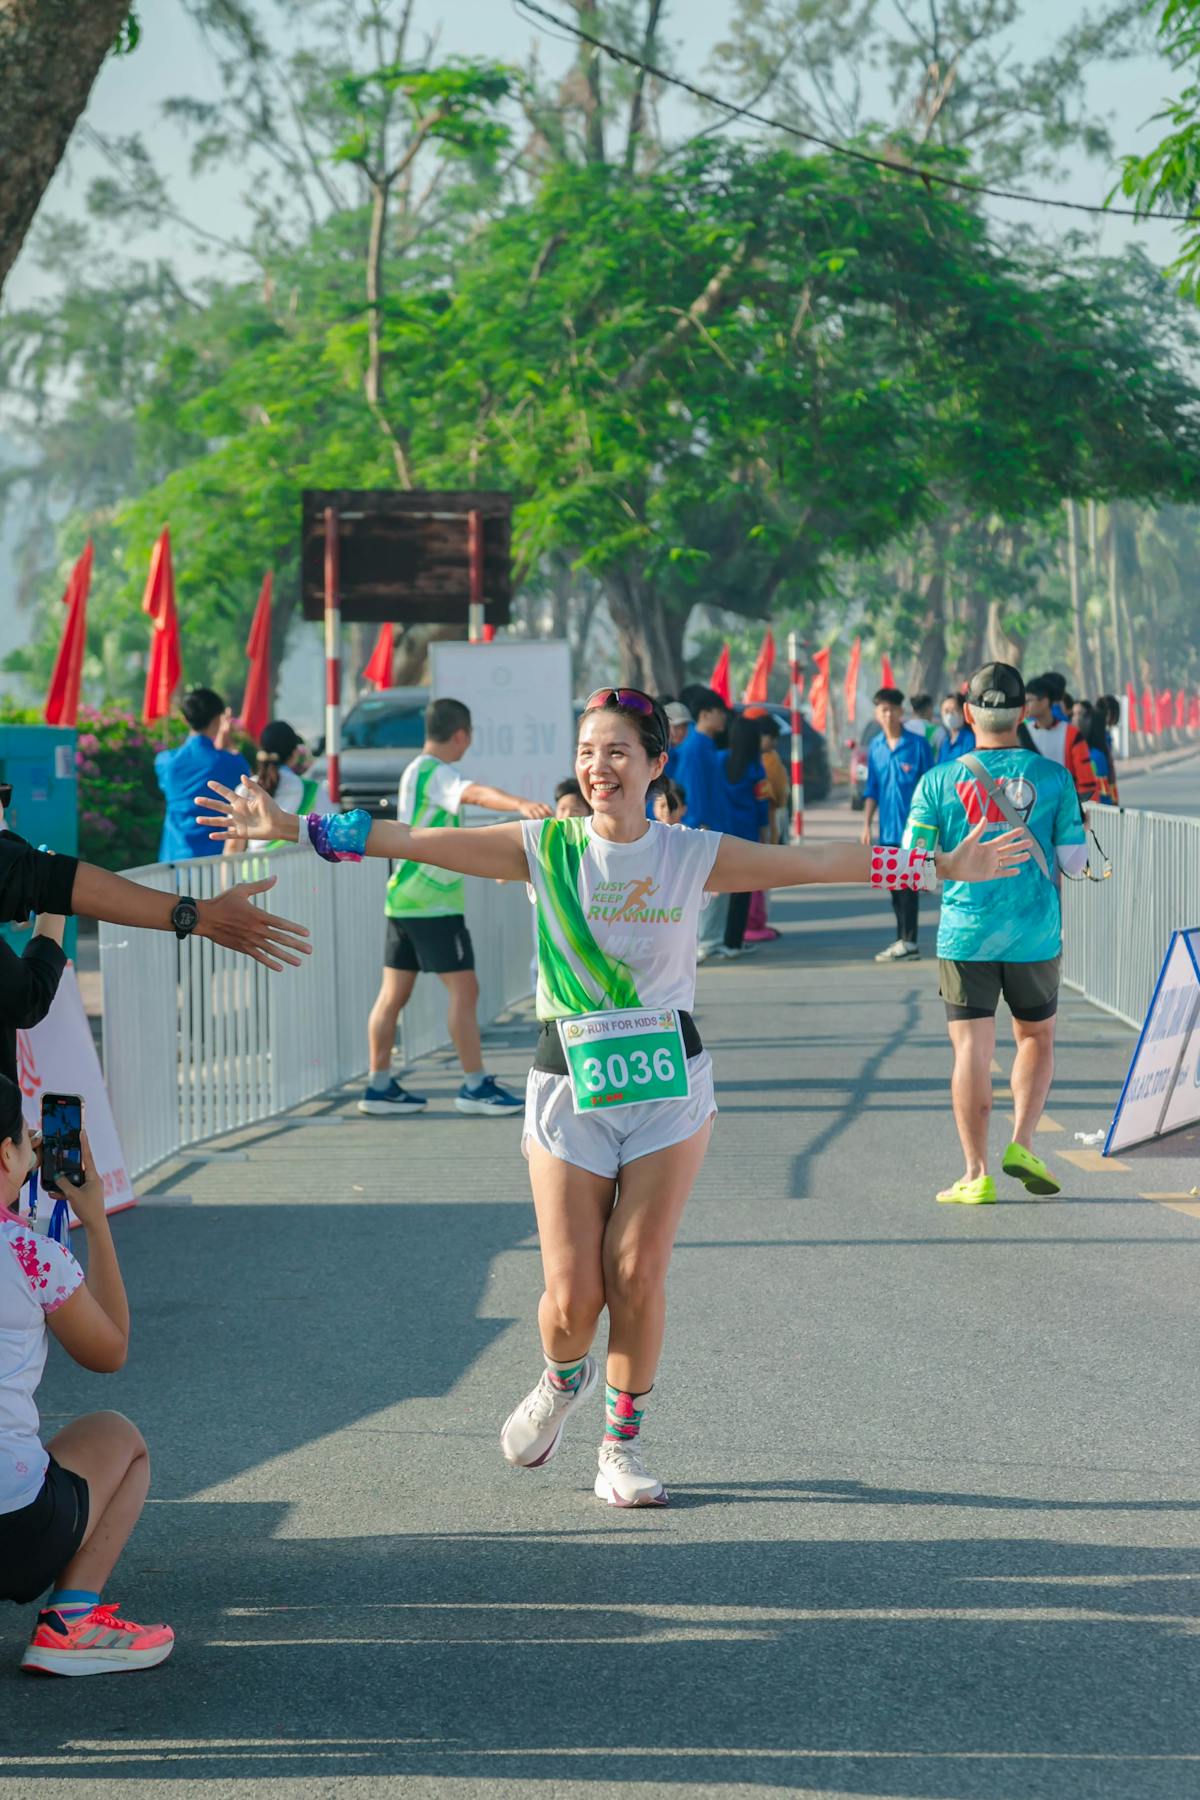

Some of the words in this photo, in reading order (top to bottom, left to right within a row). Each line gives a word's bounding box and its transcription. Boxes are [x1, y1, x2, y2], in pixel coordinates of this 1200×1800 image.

[595, 881, 625, 892] JUST
[592, 892, 624, 903] KEEP
[587, 904, 683, 923] RUNNING
[587, 1021, 610, 1034] RUN
[611, 1019, 633, 1031] FOR
[635, 1016, 658, 1028] KIDS
[583, 1047, 675, 1092] 3036
